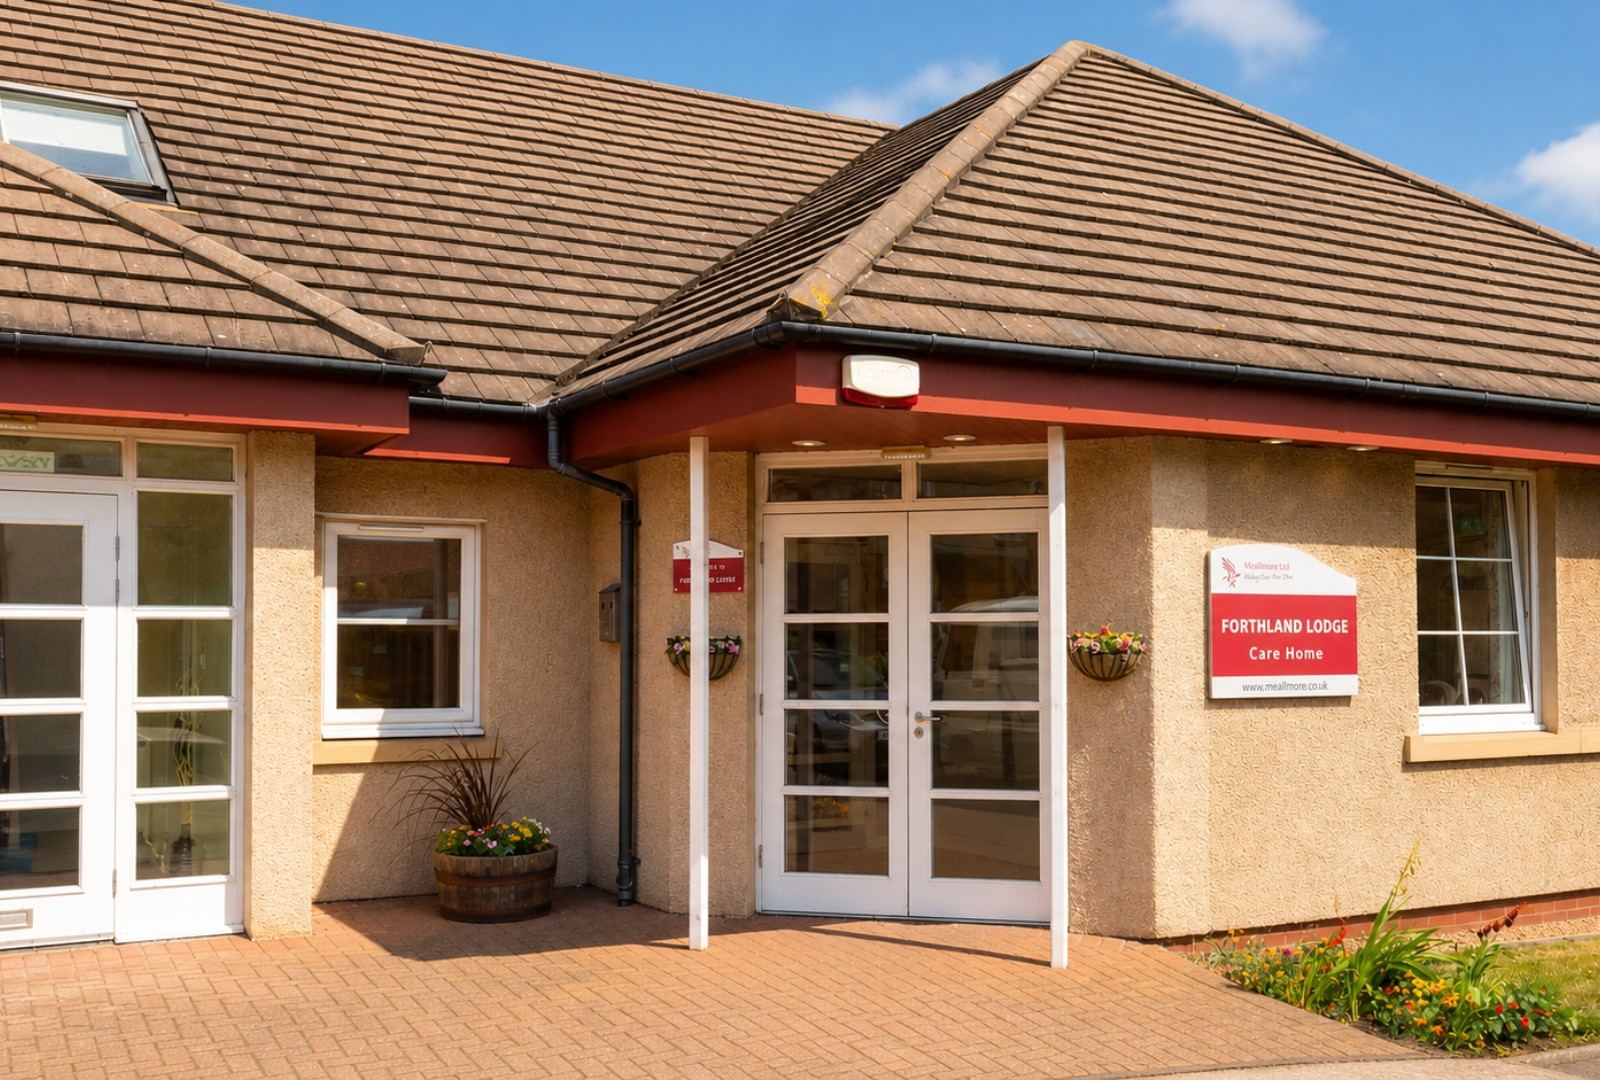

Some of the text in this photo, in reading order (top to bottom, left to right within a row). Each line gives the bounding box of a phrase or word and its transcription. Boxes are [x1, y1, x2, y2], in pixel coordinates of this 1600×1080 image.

[1279, 562, 1290, 571] Ltd
[1221, 619, 1348, 634] FORTHLAND LODGE
[1249, 646, 1324, 660] Care Home
[1242, 681, 1328, 693] www.meallmore.co.uk
